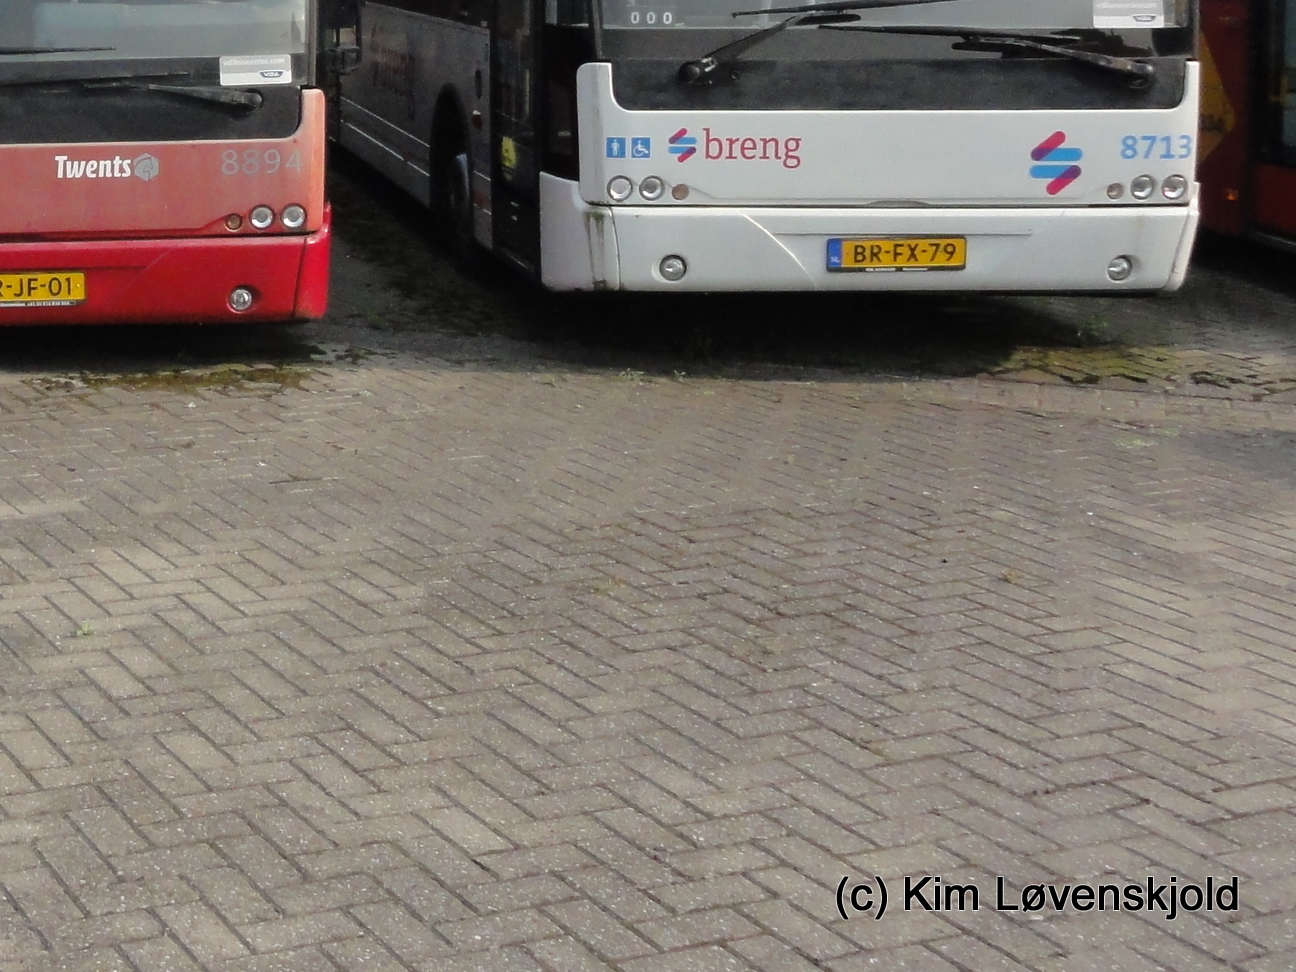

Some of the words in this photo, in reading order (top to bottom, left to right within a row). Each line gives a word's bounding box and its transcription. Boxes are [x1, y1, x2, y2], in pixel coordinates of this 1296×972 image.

[702, 128, 802, 169] breng
[1120, 134, 1192, 160] 8713
[54, 155, 132, 179] Twents
[221, 148, 304, 175] 8894
[854, 243, 957, 263] BR-FX-79
